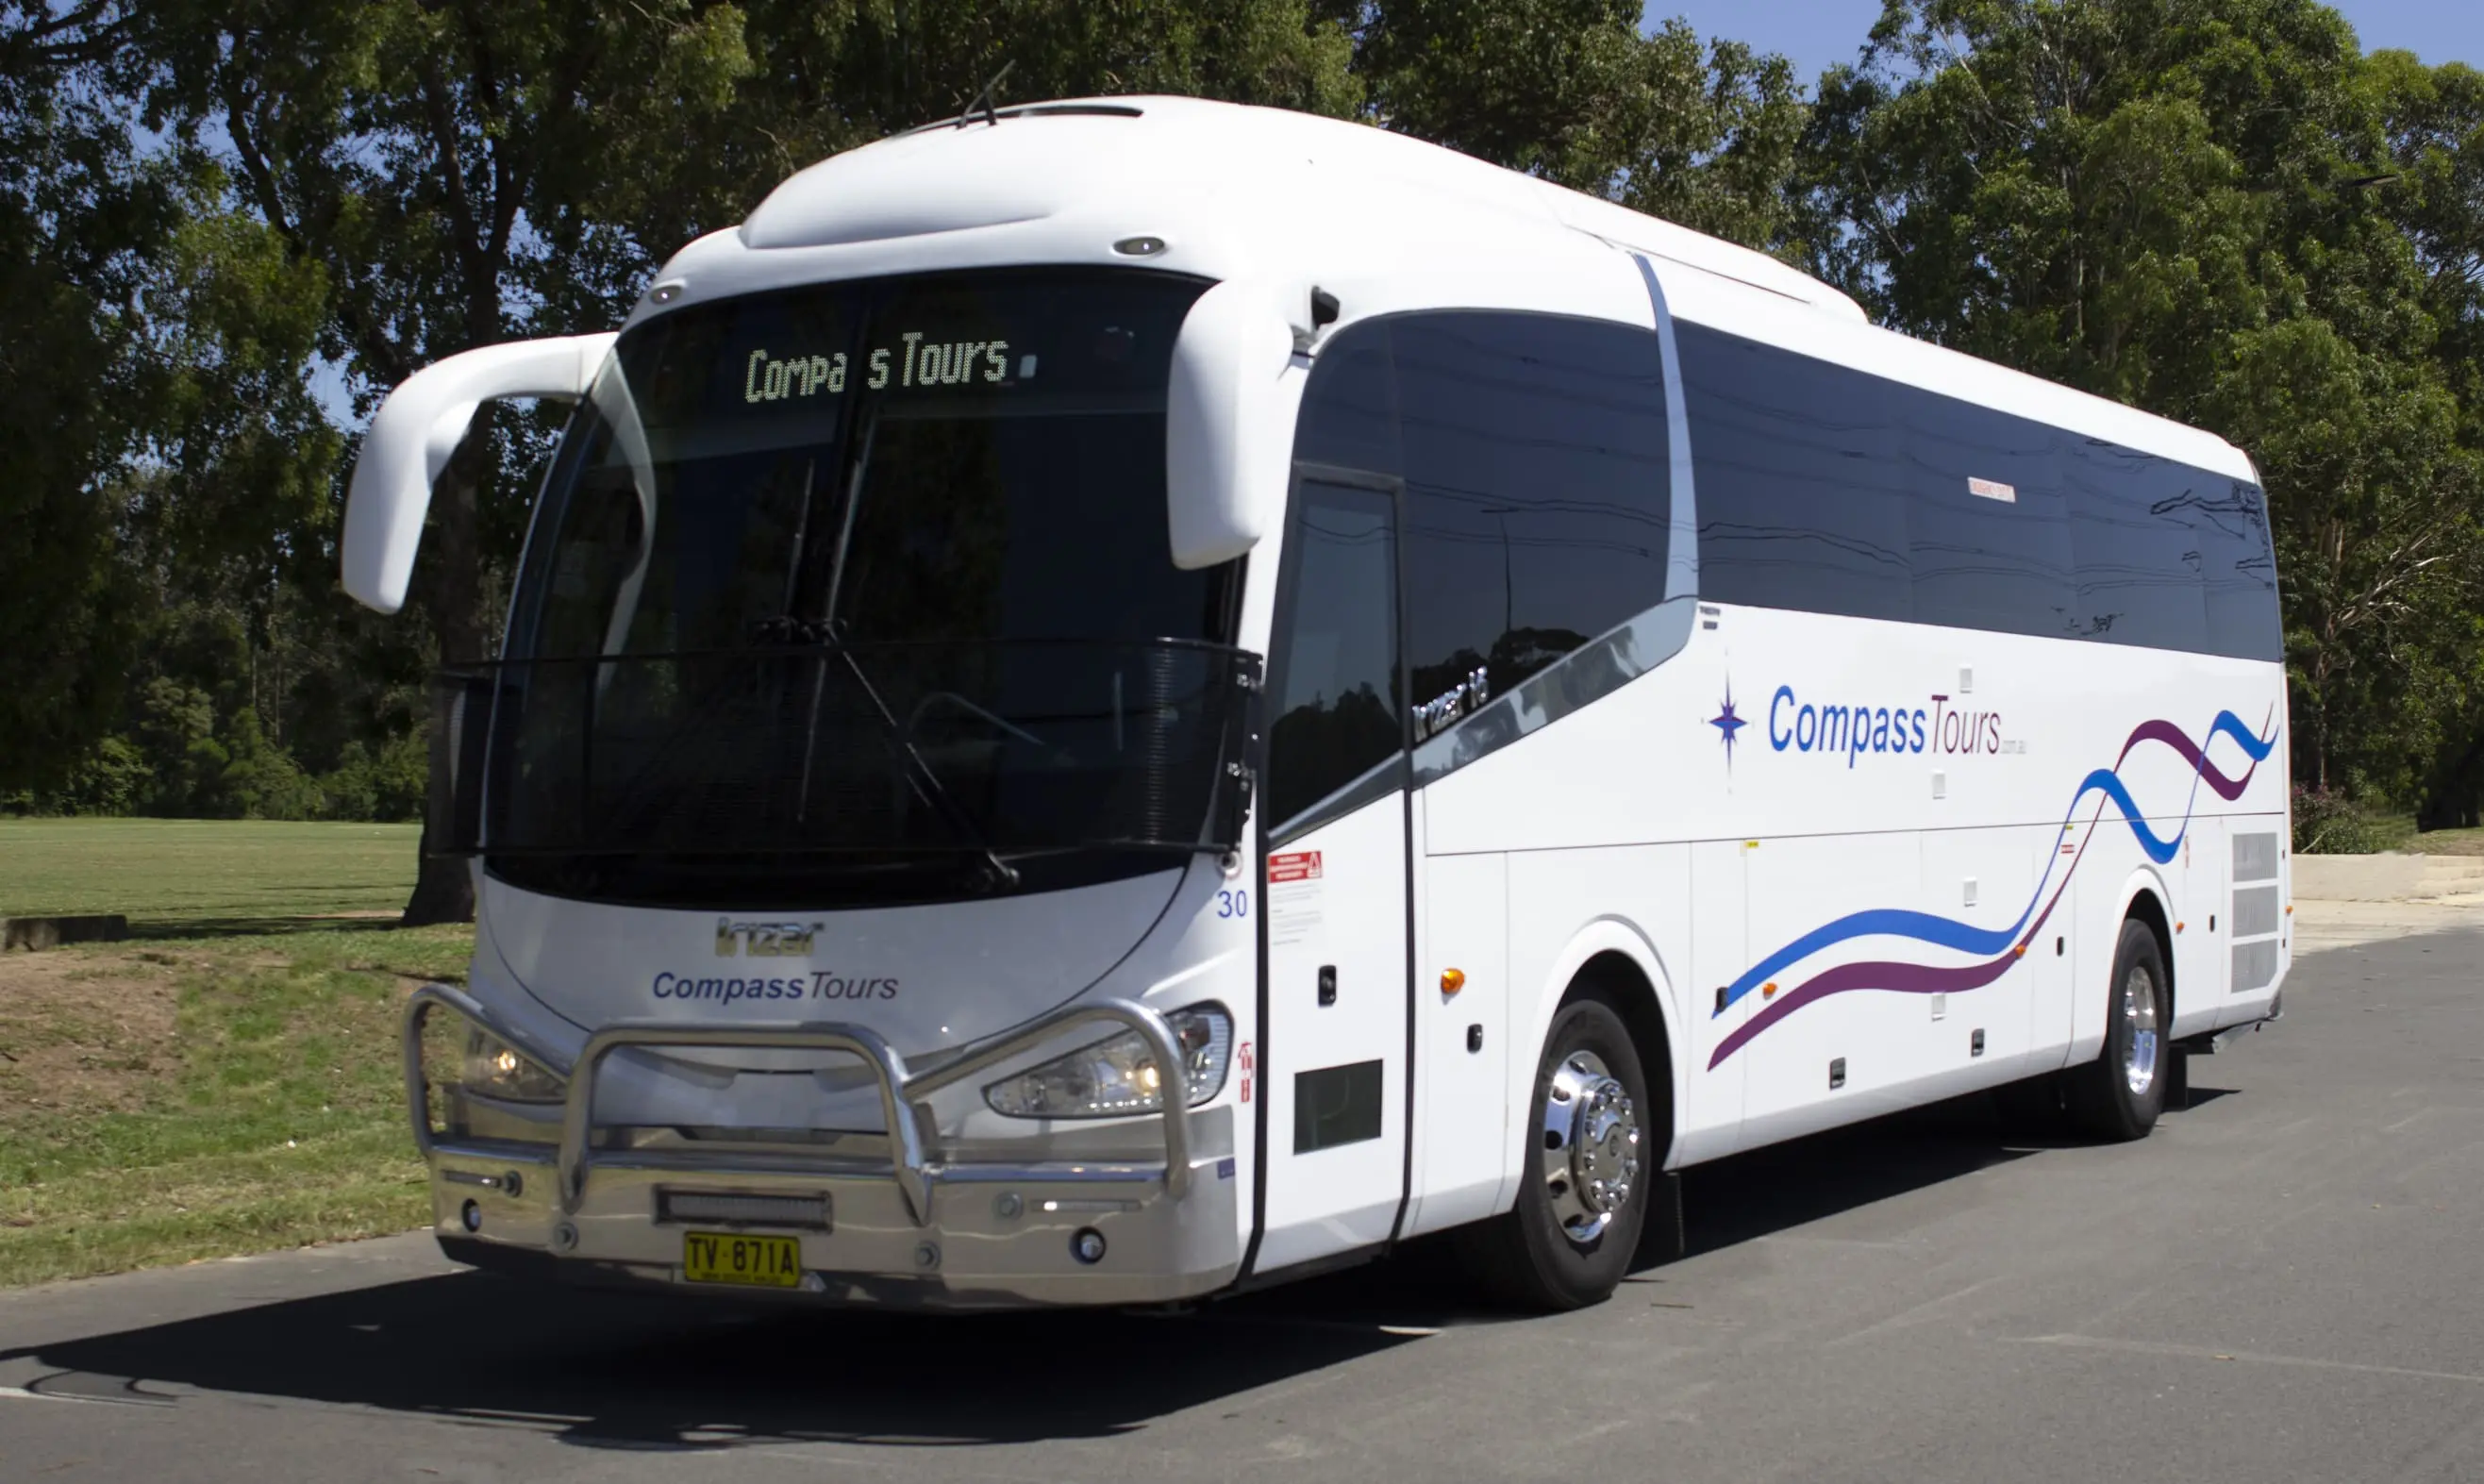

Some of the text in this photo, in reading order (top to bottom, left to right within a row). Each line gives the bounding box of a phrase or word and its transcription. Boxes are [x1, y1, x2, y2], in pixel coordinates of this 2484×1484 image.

[745, 331, 1009, 403] Compas Tours
[1217, 890, 1247, 918] 30
[689, 1237, 794, 1276] TV 871A
